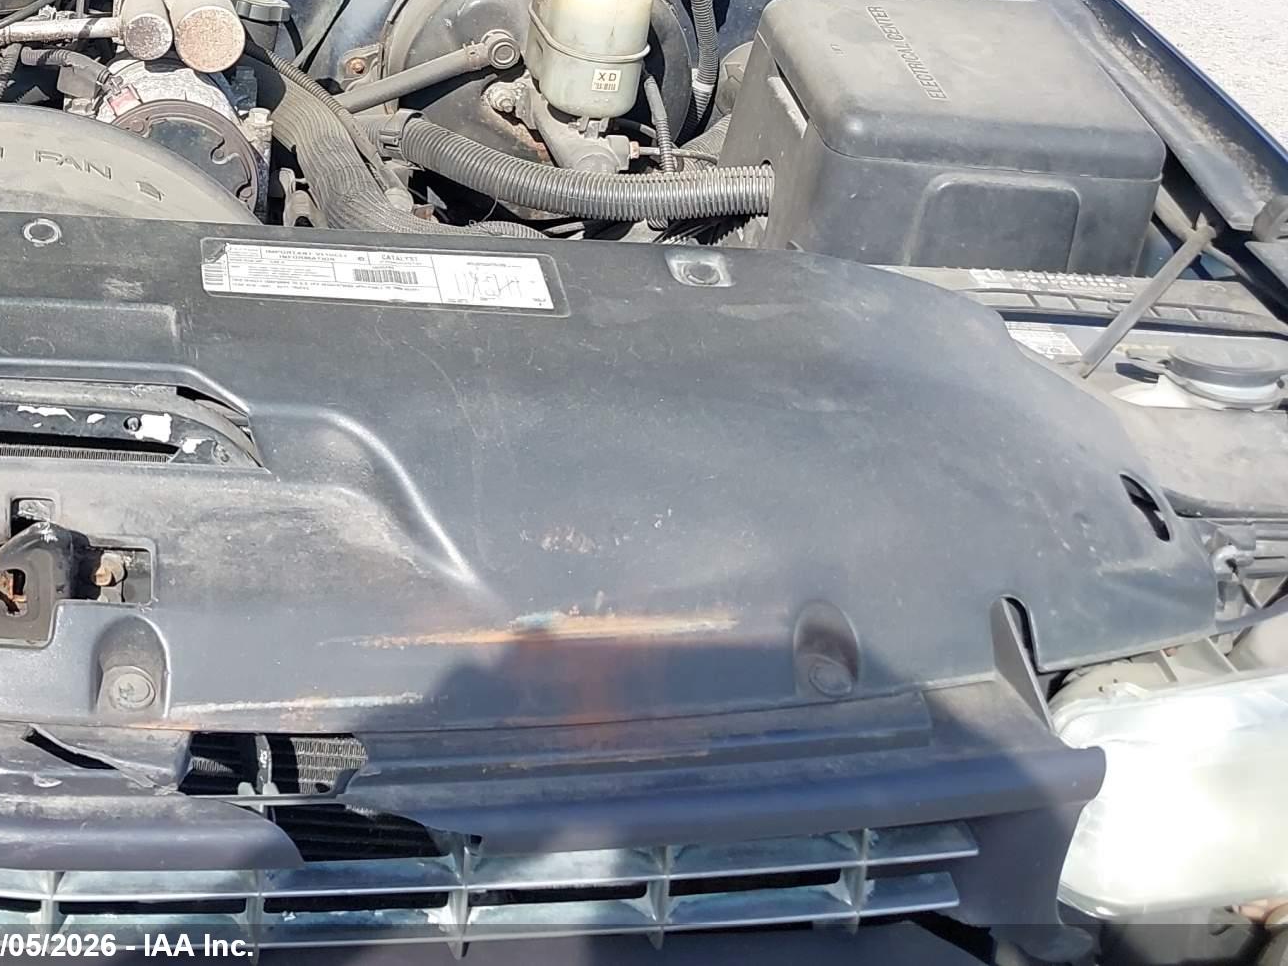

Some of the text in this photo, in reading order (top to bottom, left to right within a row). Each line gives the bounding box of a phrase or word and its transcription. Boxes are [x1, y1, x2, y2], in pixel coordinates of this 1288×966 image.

[866, 5, 949, 101] ELECTRICAL CENTER
[34, 149, 113, 180] FAN
[278, 254, 335, 262] INFORMATION
[381, 253, 419, 262] CATALYST
